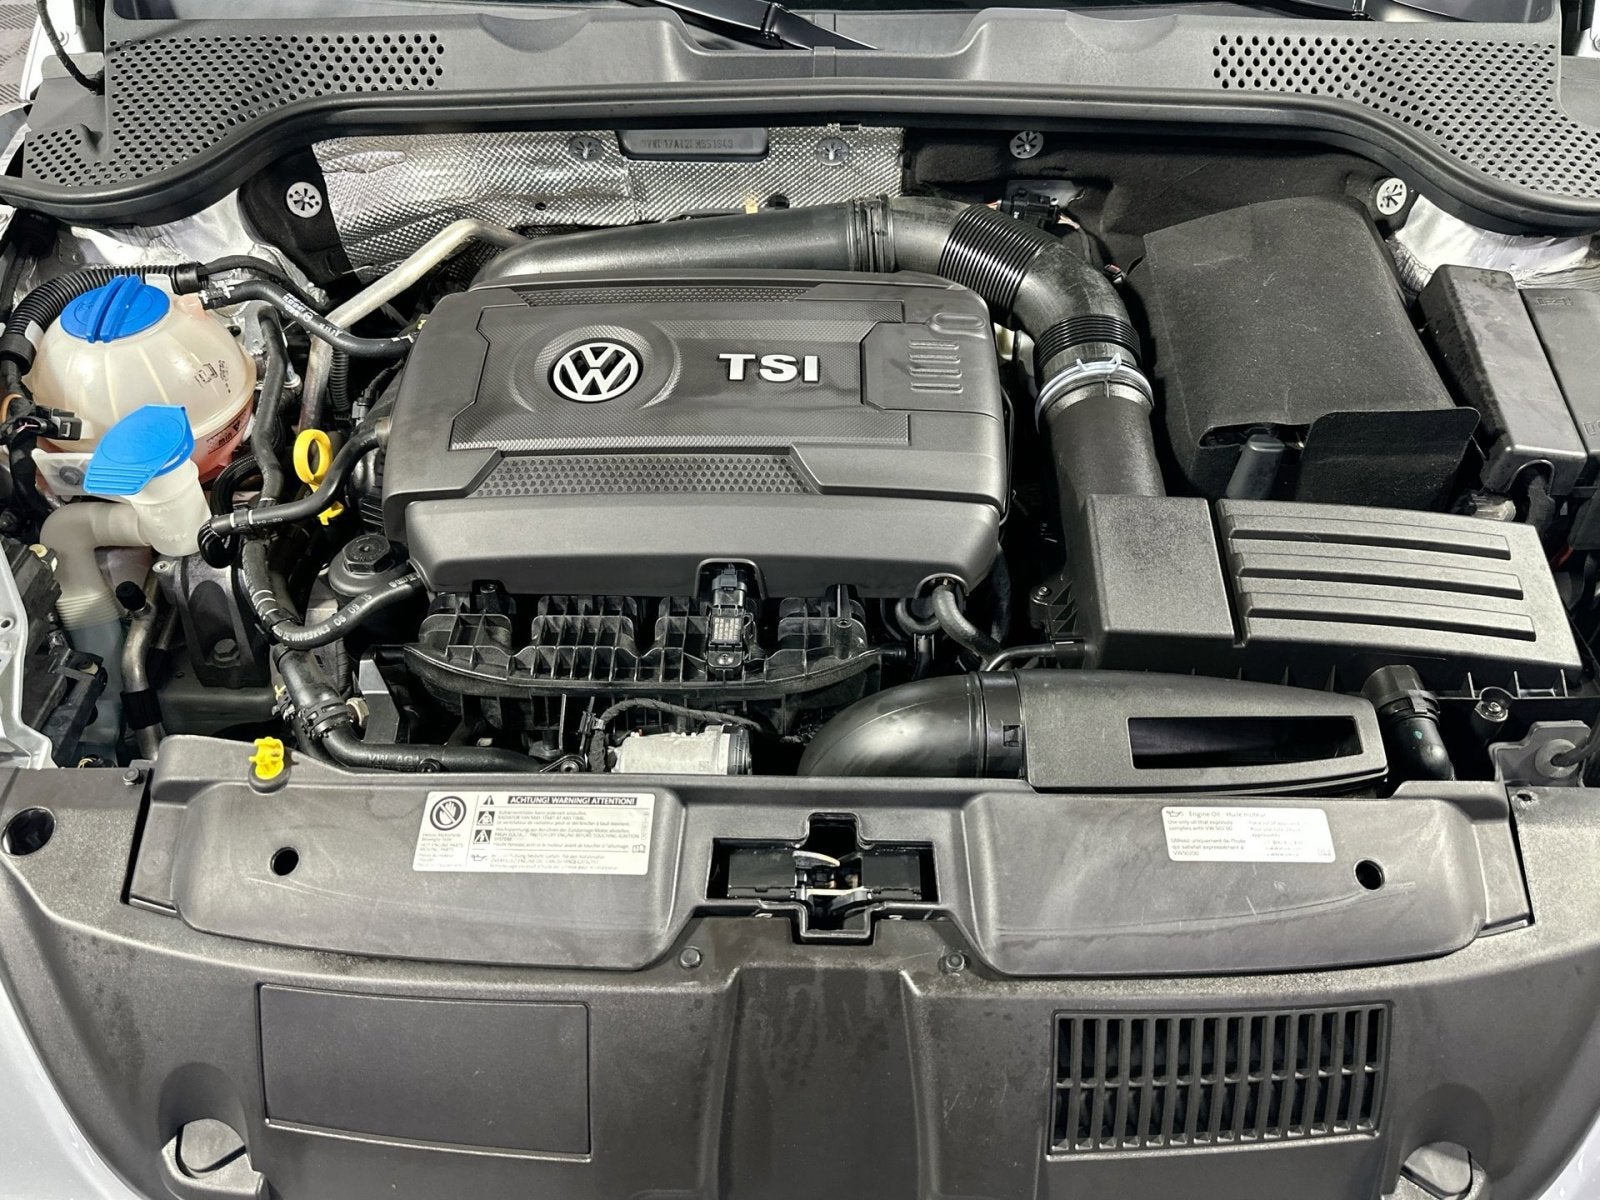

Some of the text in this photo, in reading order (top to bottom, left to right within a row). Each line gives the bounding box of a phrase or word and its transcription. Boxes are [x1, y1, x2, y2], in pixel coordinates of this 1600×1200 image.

[553, 342, 819, 402] VW TSI
[510, 796, 636, 806] ACHTUNG! WARNING! ATTENTION!
